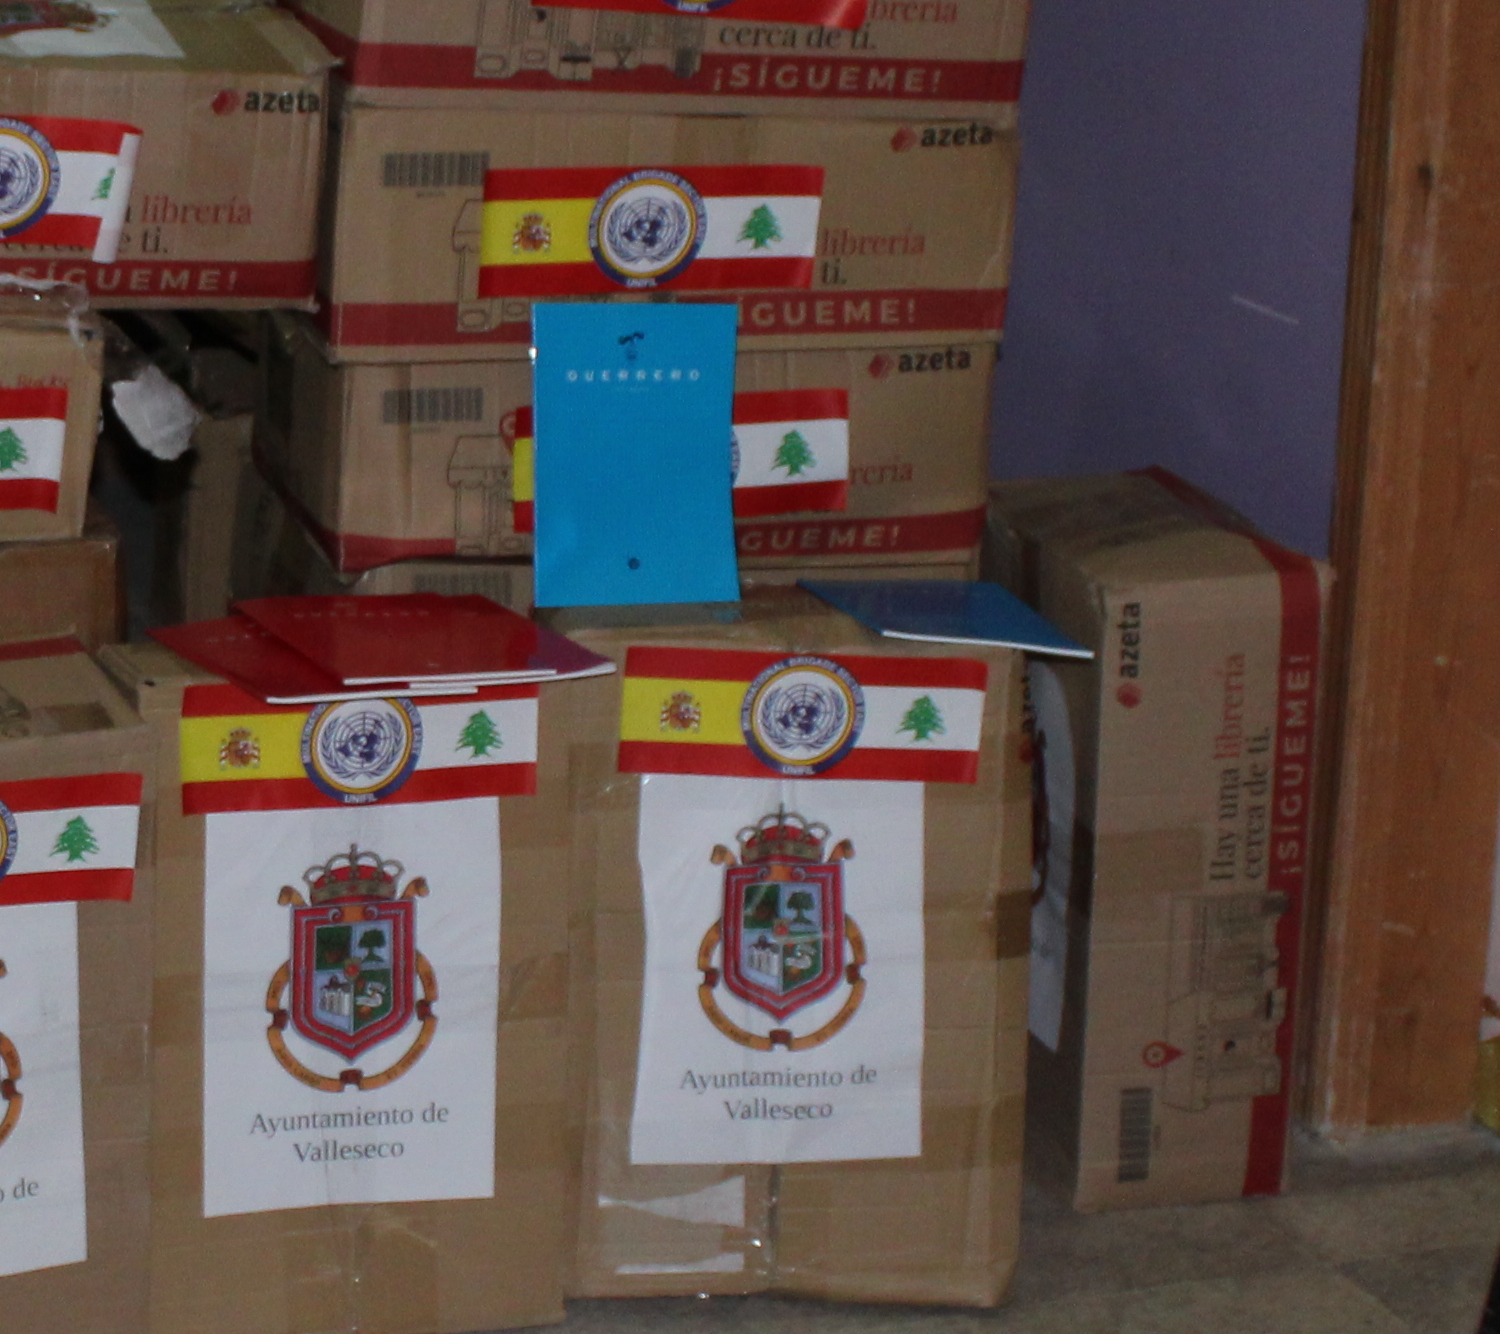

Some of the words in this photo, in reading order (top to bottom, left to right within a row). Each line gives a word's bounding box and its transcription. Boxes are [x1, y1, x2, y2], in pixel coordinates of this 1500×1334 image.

[720, 25, 797, 50] cerca
[807, 26, 842, 50] de
[713, 57, 943, 94] ¡SÍGUEME!
[245, 90, 320, 113] azeta
[921, 123, 994, 147] azeta
[12, 263, 239, 293] SÍGUEME!
[738, 295, 917, 327] ÍGUEME!
[898, 347, 972, 372] azeta
[740, 524, 900, 551] GUEME!
[1116, 601, 1141, 678] azeta
[1242, 763, 1268, 797] de
[1244, 804, 1266, 880] cerca
[680, 1067, 843, 1095] Ayuntamiento
[851, 1064, 877, 1085] de
[250, 1106, 414, 1138] Ayuntamiento
[421, 1101, 450, 1123] de
[723, 1098, 832, 1120] Valleseco
[293, 1140, 405, 1162] Valleseco
[12, 1177, 40, 1200] de
